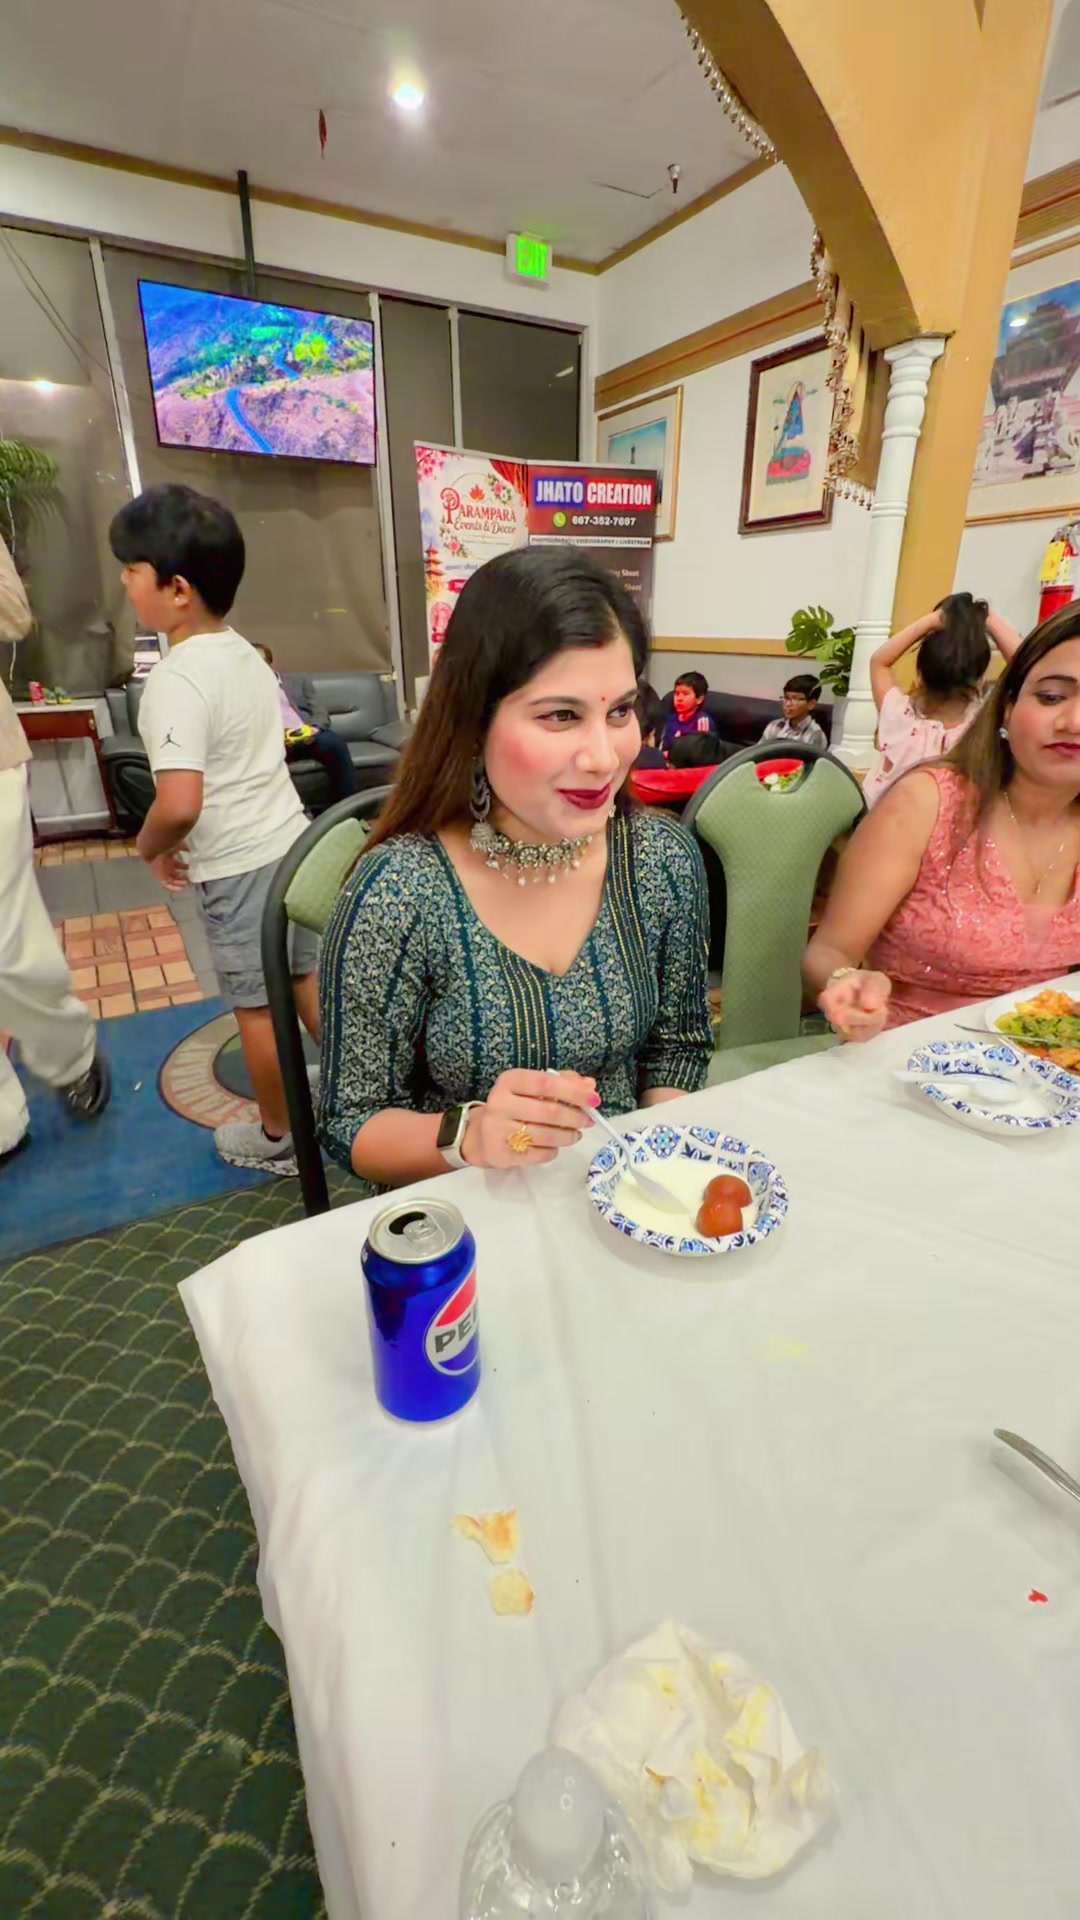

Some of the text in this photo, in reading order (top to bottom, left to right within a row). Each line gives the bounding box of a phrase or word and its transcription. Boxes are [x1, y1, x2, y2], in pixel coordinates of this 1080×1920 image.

[517, 237, 548, 279] EXIT
[440, 487, 517, 524] PARAMPARA
[536, 481, 652, 505] JHATO CREATION
[454, 517, 482, 531] Events
[484, 523, 491, 532] &
